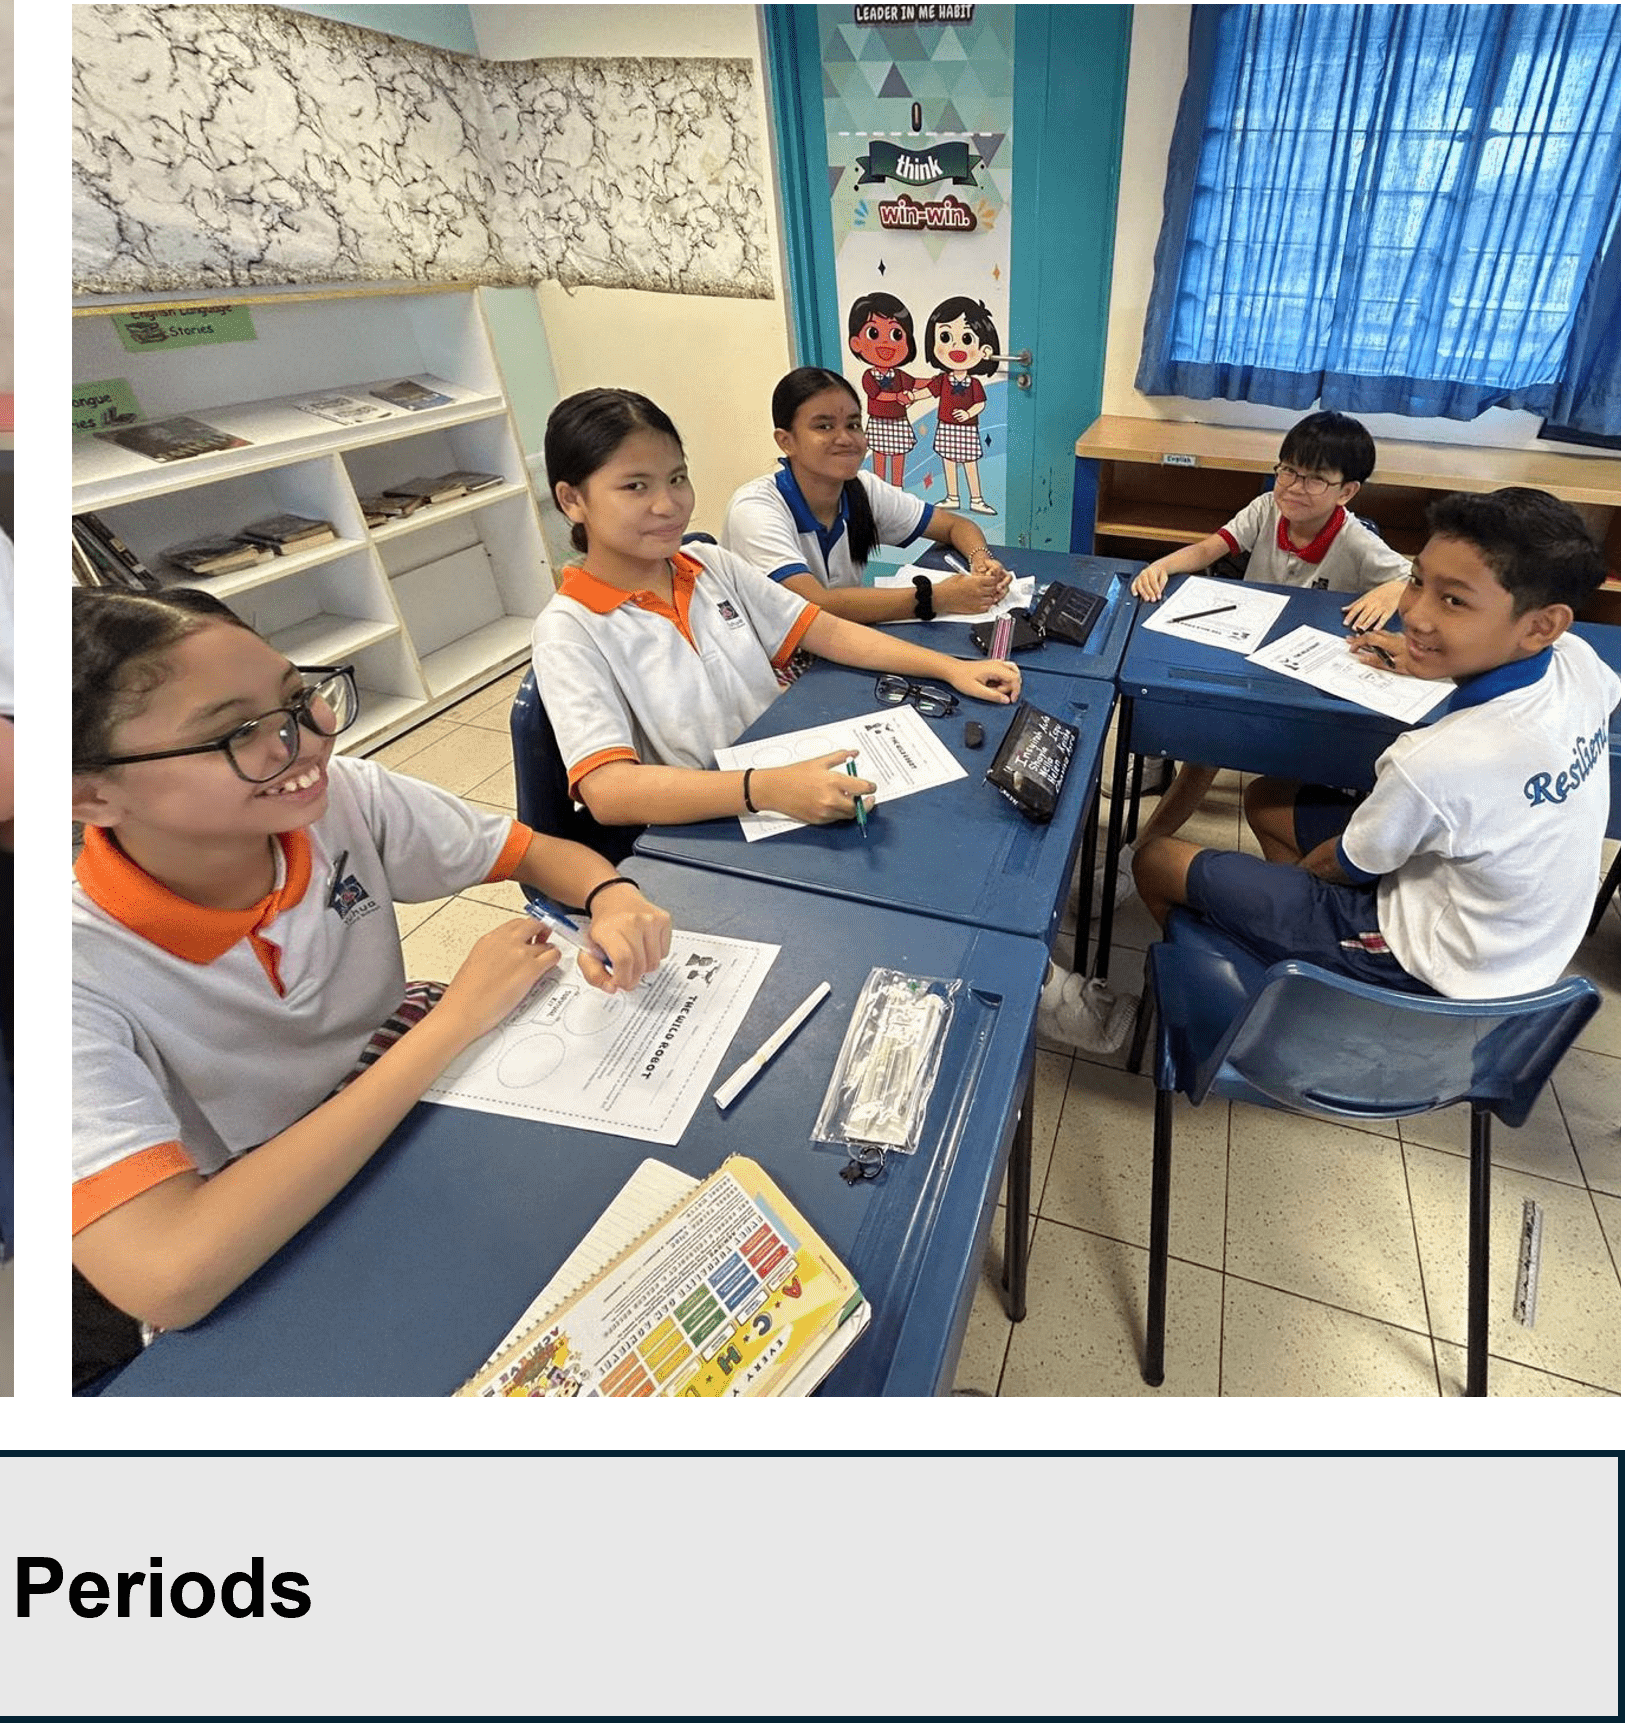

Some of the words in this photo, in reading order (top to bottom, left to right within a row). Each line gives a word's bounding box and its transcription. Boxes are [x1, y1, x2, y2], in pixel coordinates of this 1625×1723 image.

[856, 5, 898, 21] LEADER
[901, 5, 915, 20] IN
[918, 4, 936, 19] ME
[938, 3, 973, 19] HABIT
[912, 102, 922, 131] I
[895, 153, 944, 181] think
[879, 198, 972, 227] win-win.
[169, 325, 214, 337] Stories
[72, 394, 111, 408] ongue
[680, 995, 699, 1016] THE
[664, 1015, 687, 1041] WILD
[641, 1040, 671, 1080] ROBOT
[782, 1274, 803, 1299] A
[752, 1313, 772, 1336] C
[716, 1344, 743, 1376] H
[747, 1338, 784, 1382] EVERY
